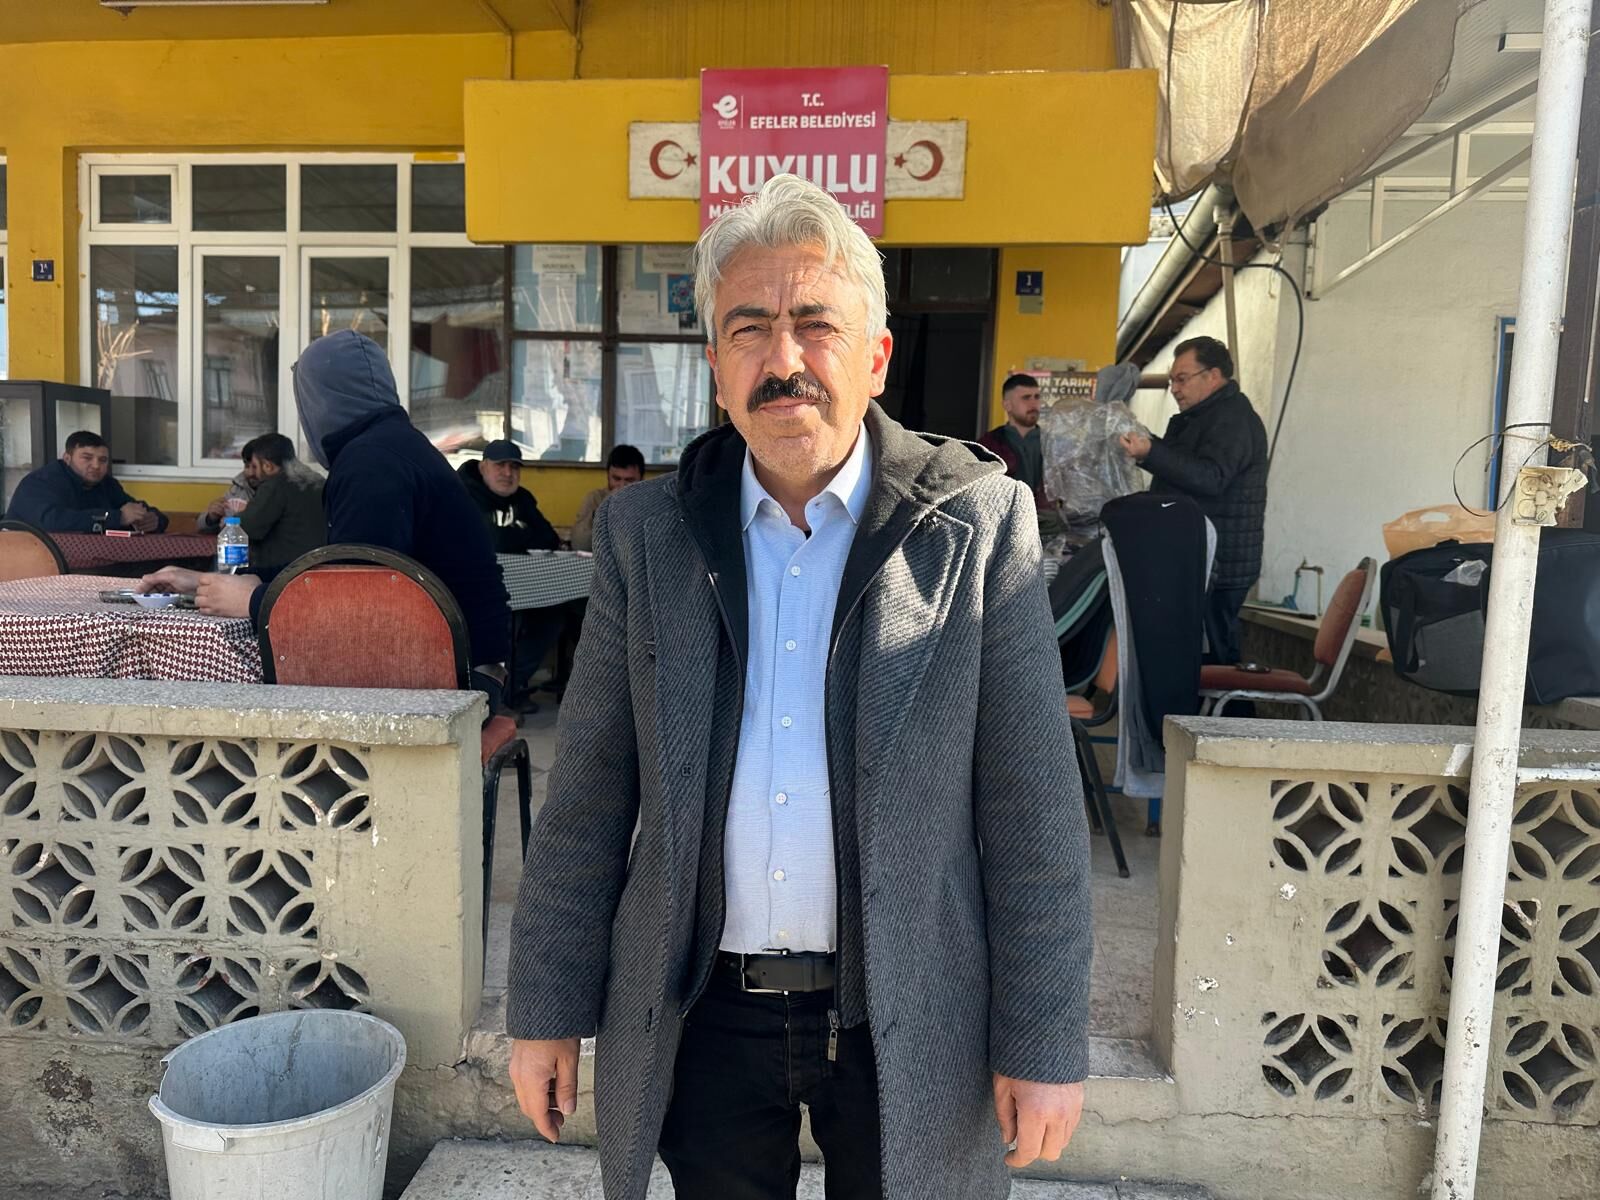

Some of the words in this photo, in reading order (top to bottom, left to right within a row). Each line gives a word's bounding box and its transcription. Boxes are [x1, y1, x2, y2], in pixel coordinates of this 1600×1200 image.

[801, 94, 825, 107] T.C.
[750, 116, 798, 129] EFELER
[801, 112, 876, 128] BELEDİYESİ
[1053, 377, 1092, 388] TARIM
